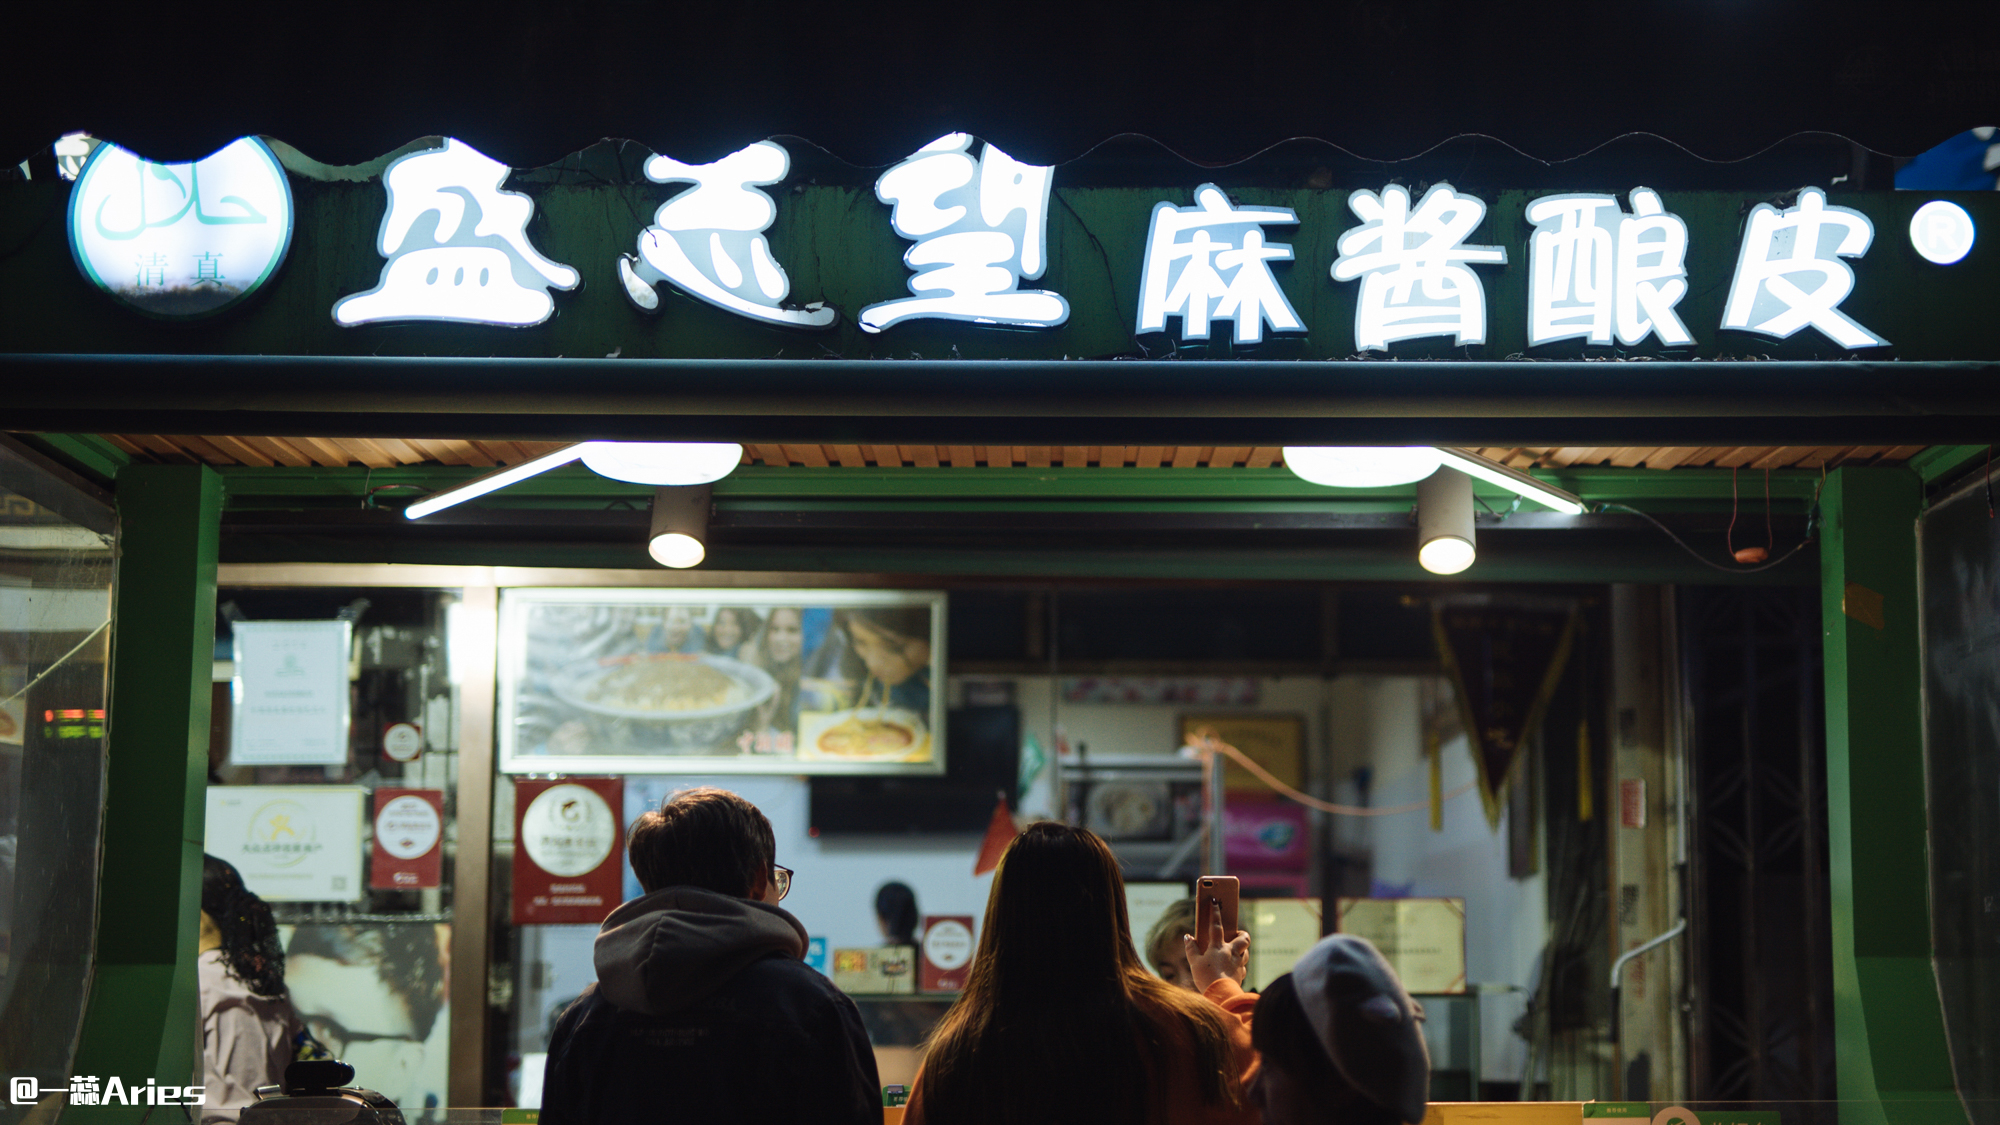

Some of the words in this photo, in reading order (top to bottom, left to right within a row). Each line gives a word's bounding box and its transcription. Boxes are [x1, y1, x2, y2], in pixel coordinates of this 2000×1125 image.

[134, 251, 226, 287] 清真
[1136, 182, 1892, 351] 麻酱酿皮
